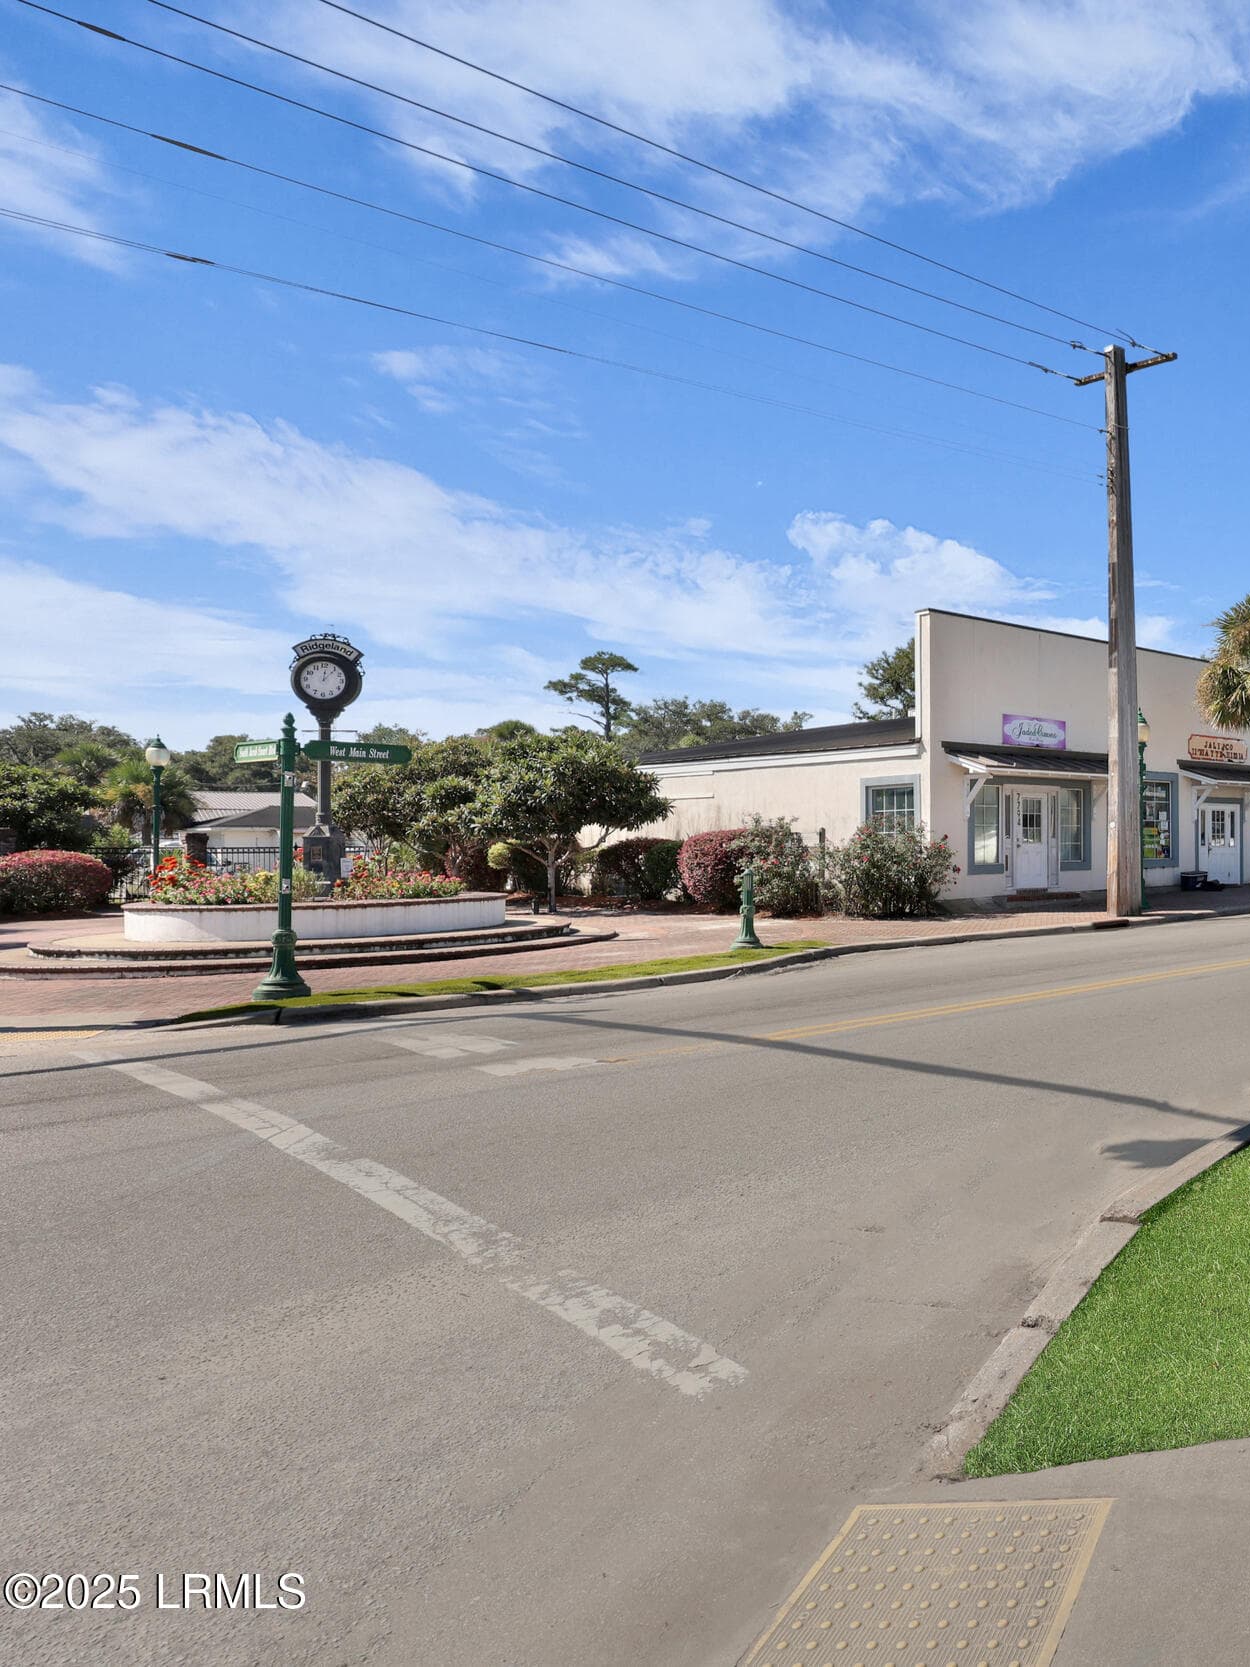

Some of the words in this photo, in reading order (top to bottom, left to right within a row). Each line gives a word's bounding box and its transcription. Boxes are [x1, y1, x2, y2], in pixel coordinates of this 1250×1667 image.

[300, 642, 354, 657] Ridgeland
[330, 746, 346, 757] West
[349, 747, 366, 758] Main
[369, 748, 390, 759] Street
